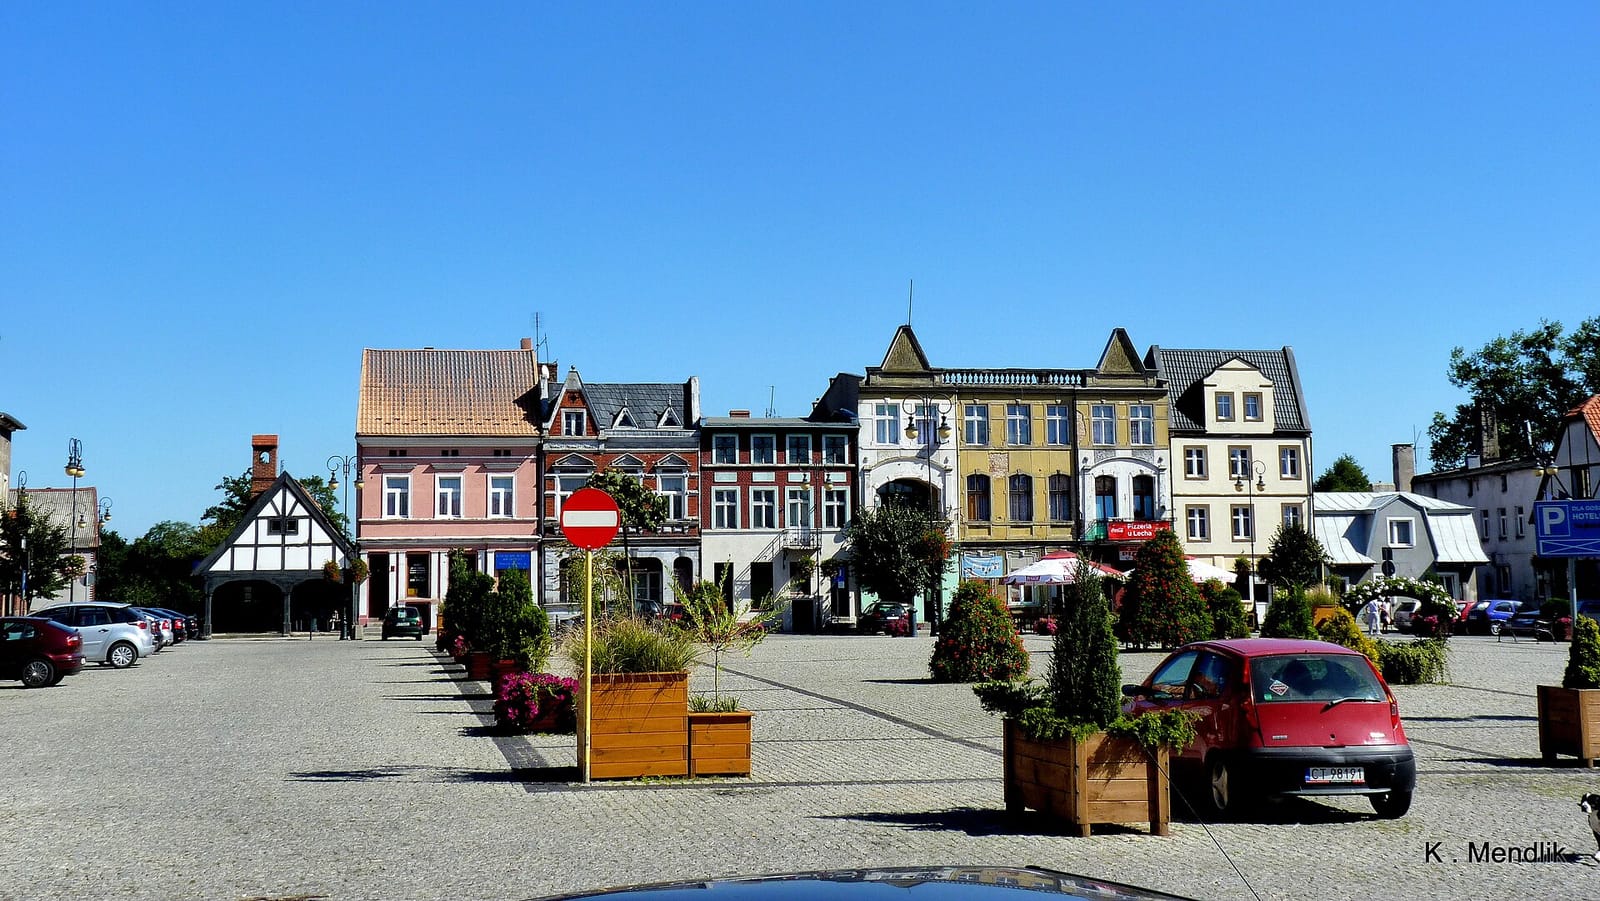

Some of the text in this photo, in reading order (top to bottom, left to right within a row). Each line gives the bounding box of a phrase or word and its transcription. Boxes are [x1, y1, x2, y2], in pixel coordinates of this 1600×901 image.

[1542, 507, 1565, 534] P
[1572, 512, 1600, 520] HOTEL
[1311, 768, 1362, 780] CT 98191
